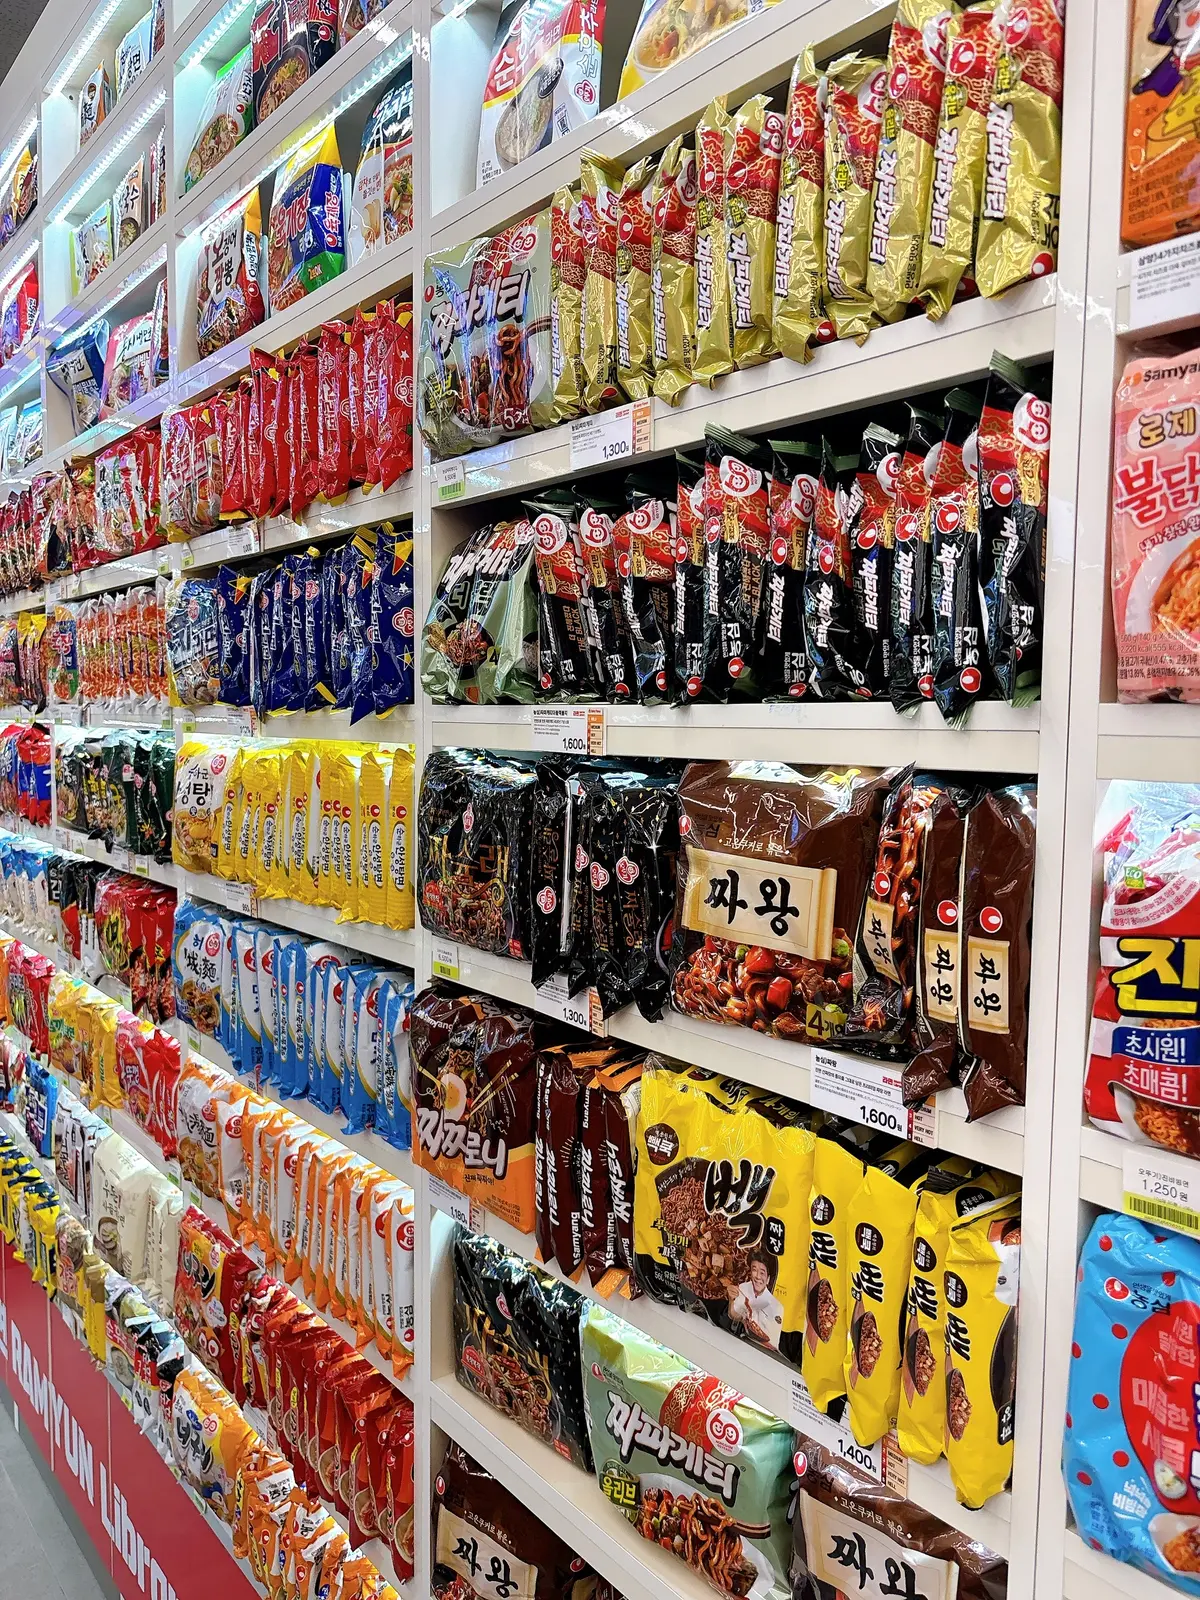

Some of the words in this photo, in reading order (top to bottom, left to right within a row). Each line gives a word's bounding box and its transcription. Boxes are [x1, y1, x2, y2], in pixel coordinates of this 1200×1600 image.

[928, 127, 957, 248] 짜파게티
[983, 101, 1014, 222] 짜파게티
[273, 187, 311, 248] 육개장
[323, 192, 340, 234] 육개장
[869, 149, 897, 266] 짜파게티
[212, 228, 238, 268] 오징어
[214, 256, 234, 295] 짬뽕
[774, 194, 796, 298] 짜파게티
[695, 234, 713, 331] 짜파게티
[727, 232, 756, 329] 짜파게티
[1138, 407, 1197, 449] 로제
[707, 550, 721, 616] 짜파게티
[936, 542, 957, 617] 짜파게티
[999, 515, 1018, 595] 짜파게티
[767, 573, 785, 643] 짜파게티
[815, 581, 833, 649] 짜파게티
[859, 558, 878, 631] 짜파게티
[895, 550, 914, 627] 짜파게티
[729, 622, 742, 657] 농심
[792, 652, 806, 684] 농심
[962, 627, 979, 666] 농심
[373, 844, 383, 883] 안성탕면
[395, 846, 406, 886] 안성탕면
[703, 869, 800, 937] 짜왕
[868, 912, 892, 965] 짜왕
[931, 943, 955, 1005] 짜왕
[973, 952, 1002, 1016] 짜왕
[1125, 1031, 1187, 1064] 초시원!
[1123, 1060, 1188, 1103] 초매콤!
[416, 1107, 508, 1181] 짜짜로니
[860, 1105, 903, 1132] 1,600원
[914, 1112, 923, 1122] HOT
[581, 1142, 595, 1228] 짜짜로니
[606, 1139, 631, 1224] 짜짜로니
[768, 1220, 784, 1254] 짜장
[404, 1304, 414, 1328] 농심
[1131, 1289, 1171, 1317] 농심
[11, 1319, 95, 1508] RAMYUN
[1131, 1377, 1191, 1432] 매콤한
[605, 1390, 741, 1508] 짜파게티
[838, 1439, 877, 1474] 1,400원
[603, 1476, 637, 1506] 올리브
[840, 1496, 885, 1527] 고온쿠커로
[451, 1537, 519, 1599] 짜왕
